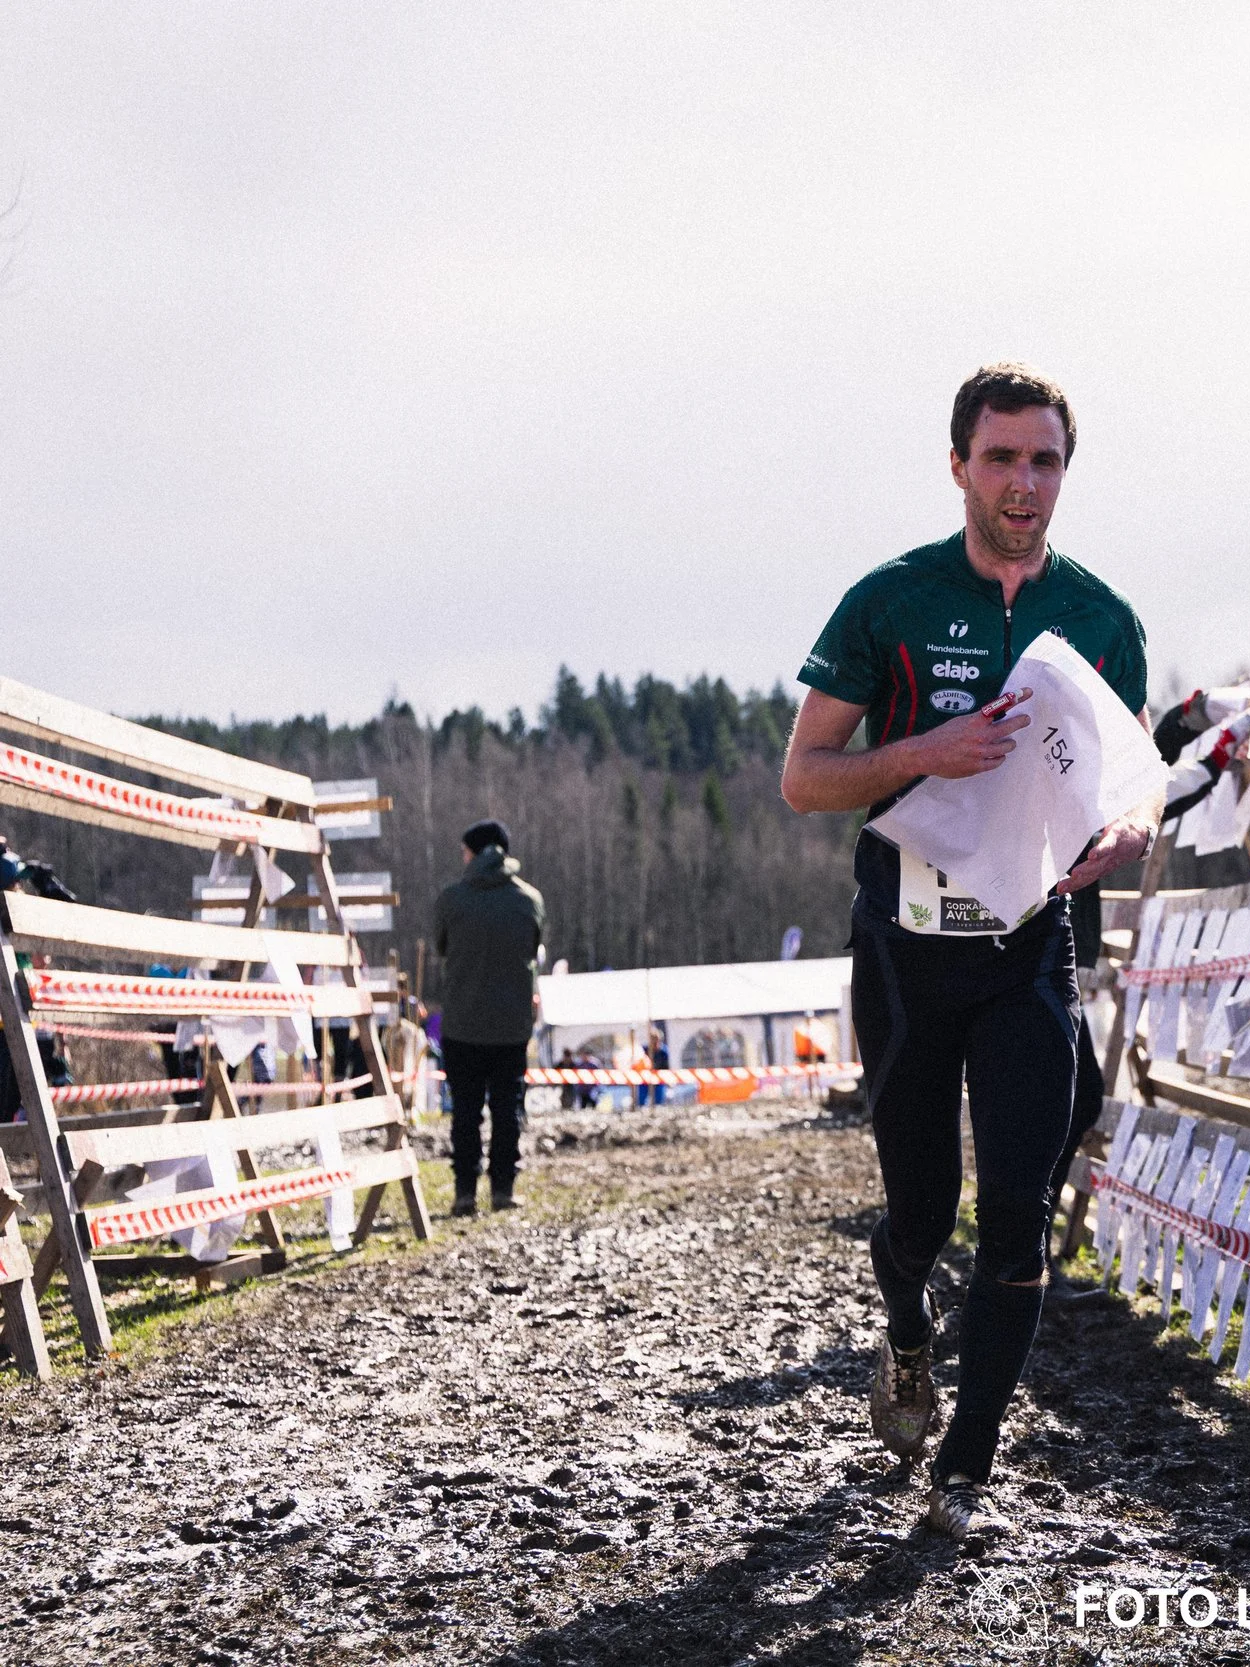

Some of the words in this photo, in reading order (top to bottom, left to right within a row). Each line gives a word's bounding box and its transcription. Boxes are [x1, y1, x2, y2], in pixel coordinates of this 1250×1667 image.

[927, 644, 989, 656] Handelsbanken
[932, 659, 980, 683] elajo
[1042, 726, 1075, 775] 154
